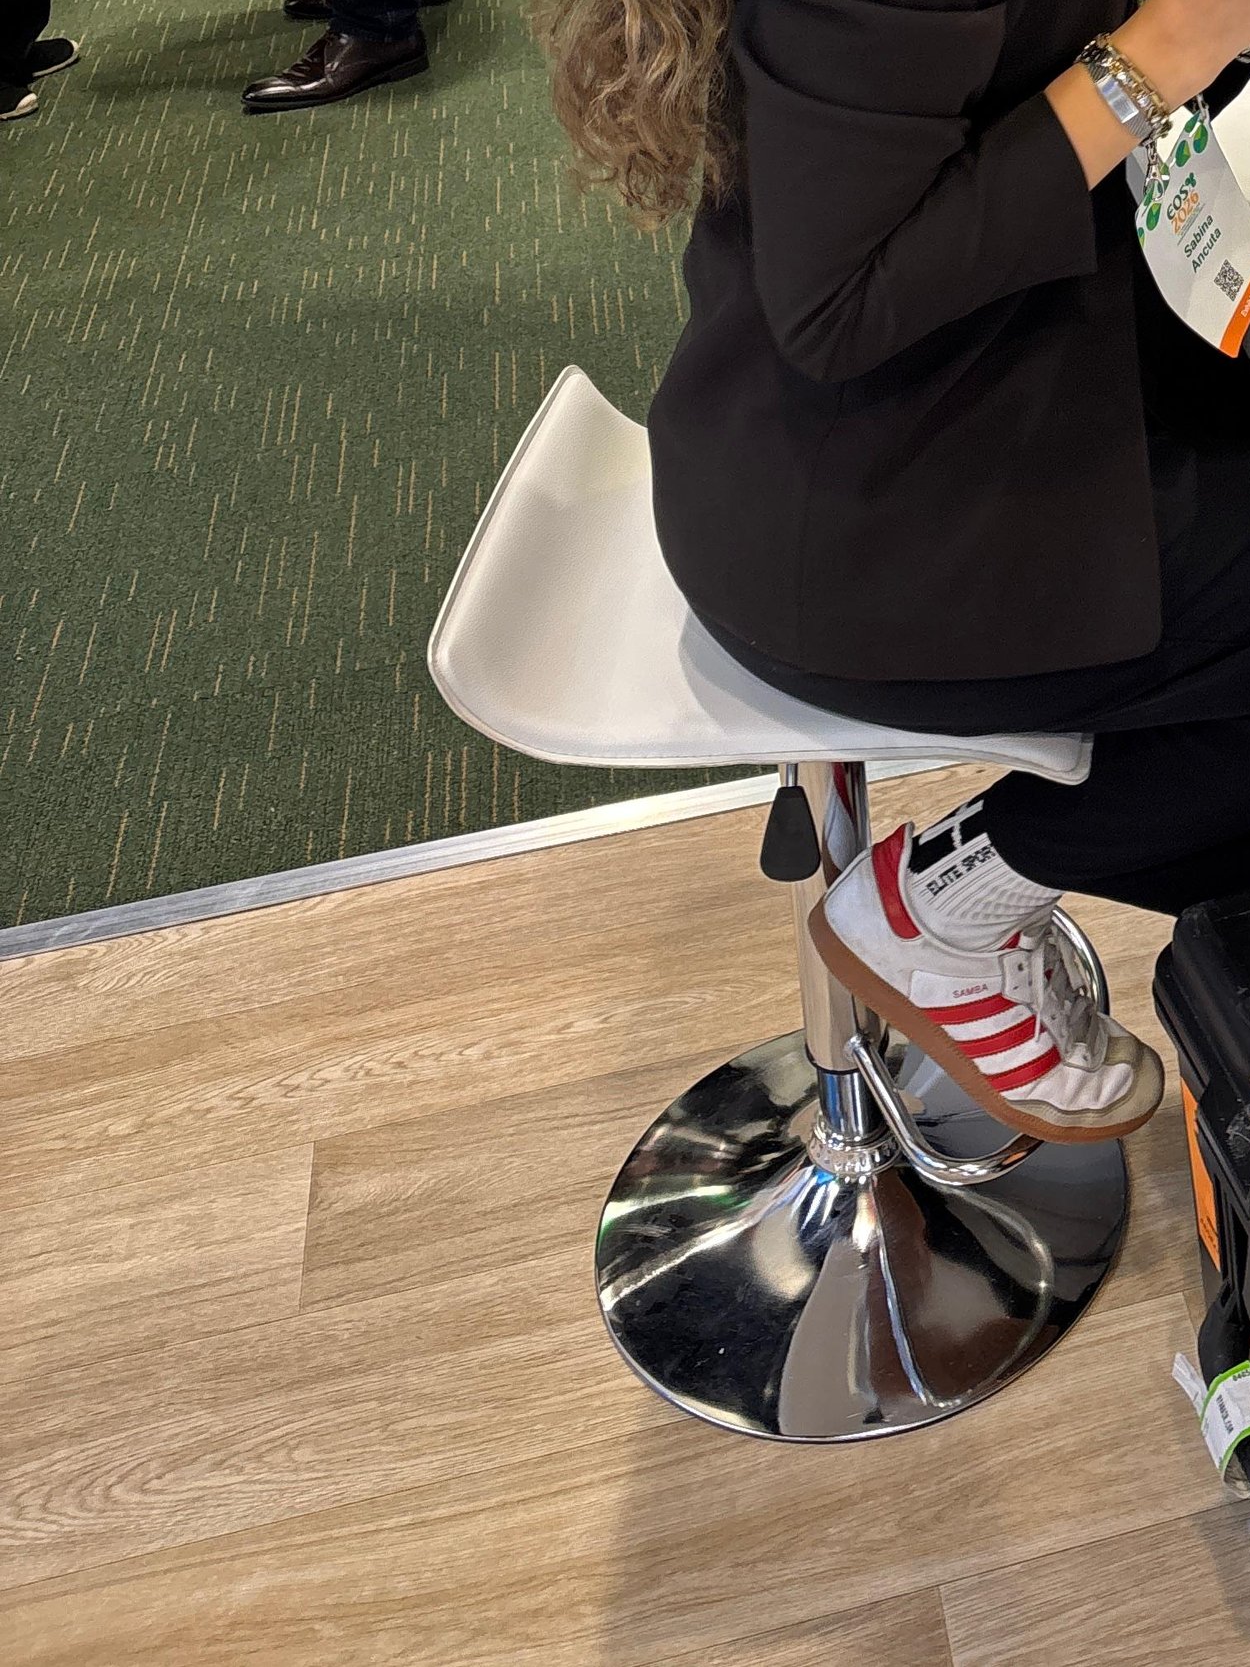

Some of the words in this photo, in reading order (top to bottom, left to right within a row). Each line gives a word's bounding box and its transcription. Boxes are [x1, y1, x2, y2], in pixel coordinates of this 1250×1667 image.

[1167, 184, 1189, 221] EOS
[1171, 190, 1202, 235] 2026
[1184, 214, 1214, 259] Sabina
[1191, 227, 1223, 274] Ancuta
[926, 865, 963, 896] ELITE
[952, 983, 988, 999] SAMBA
